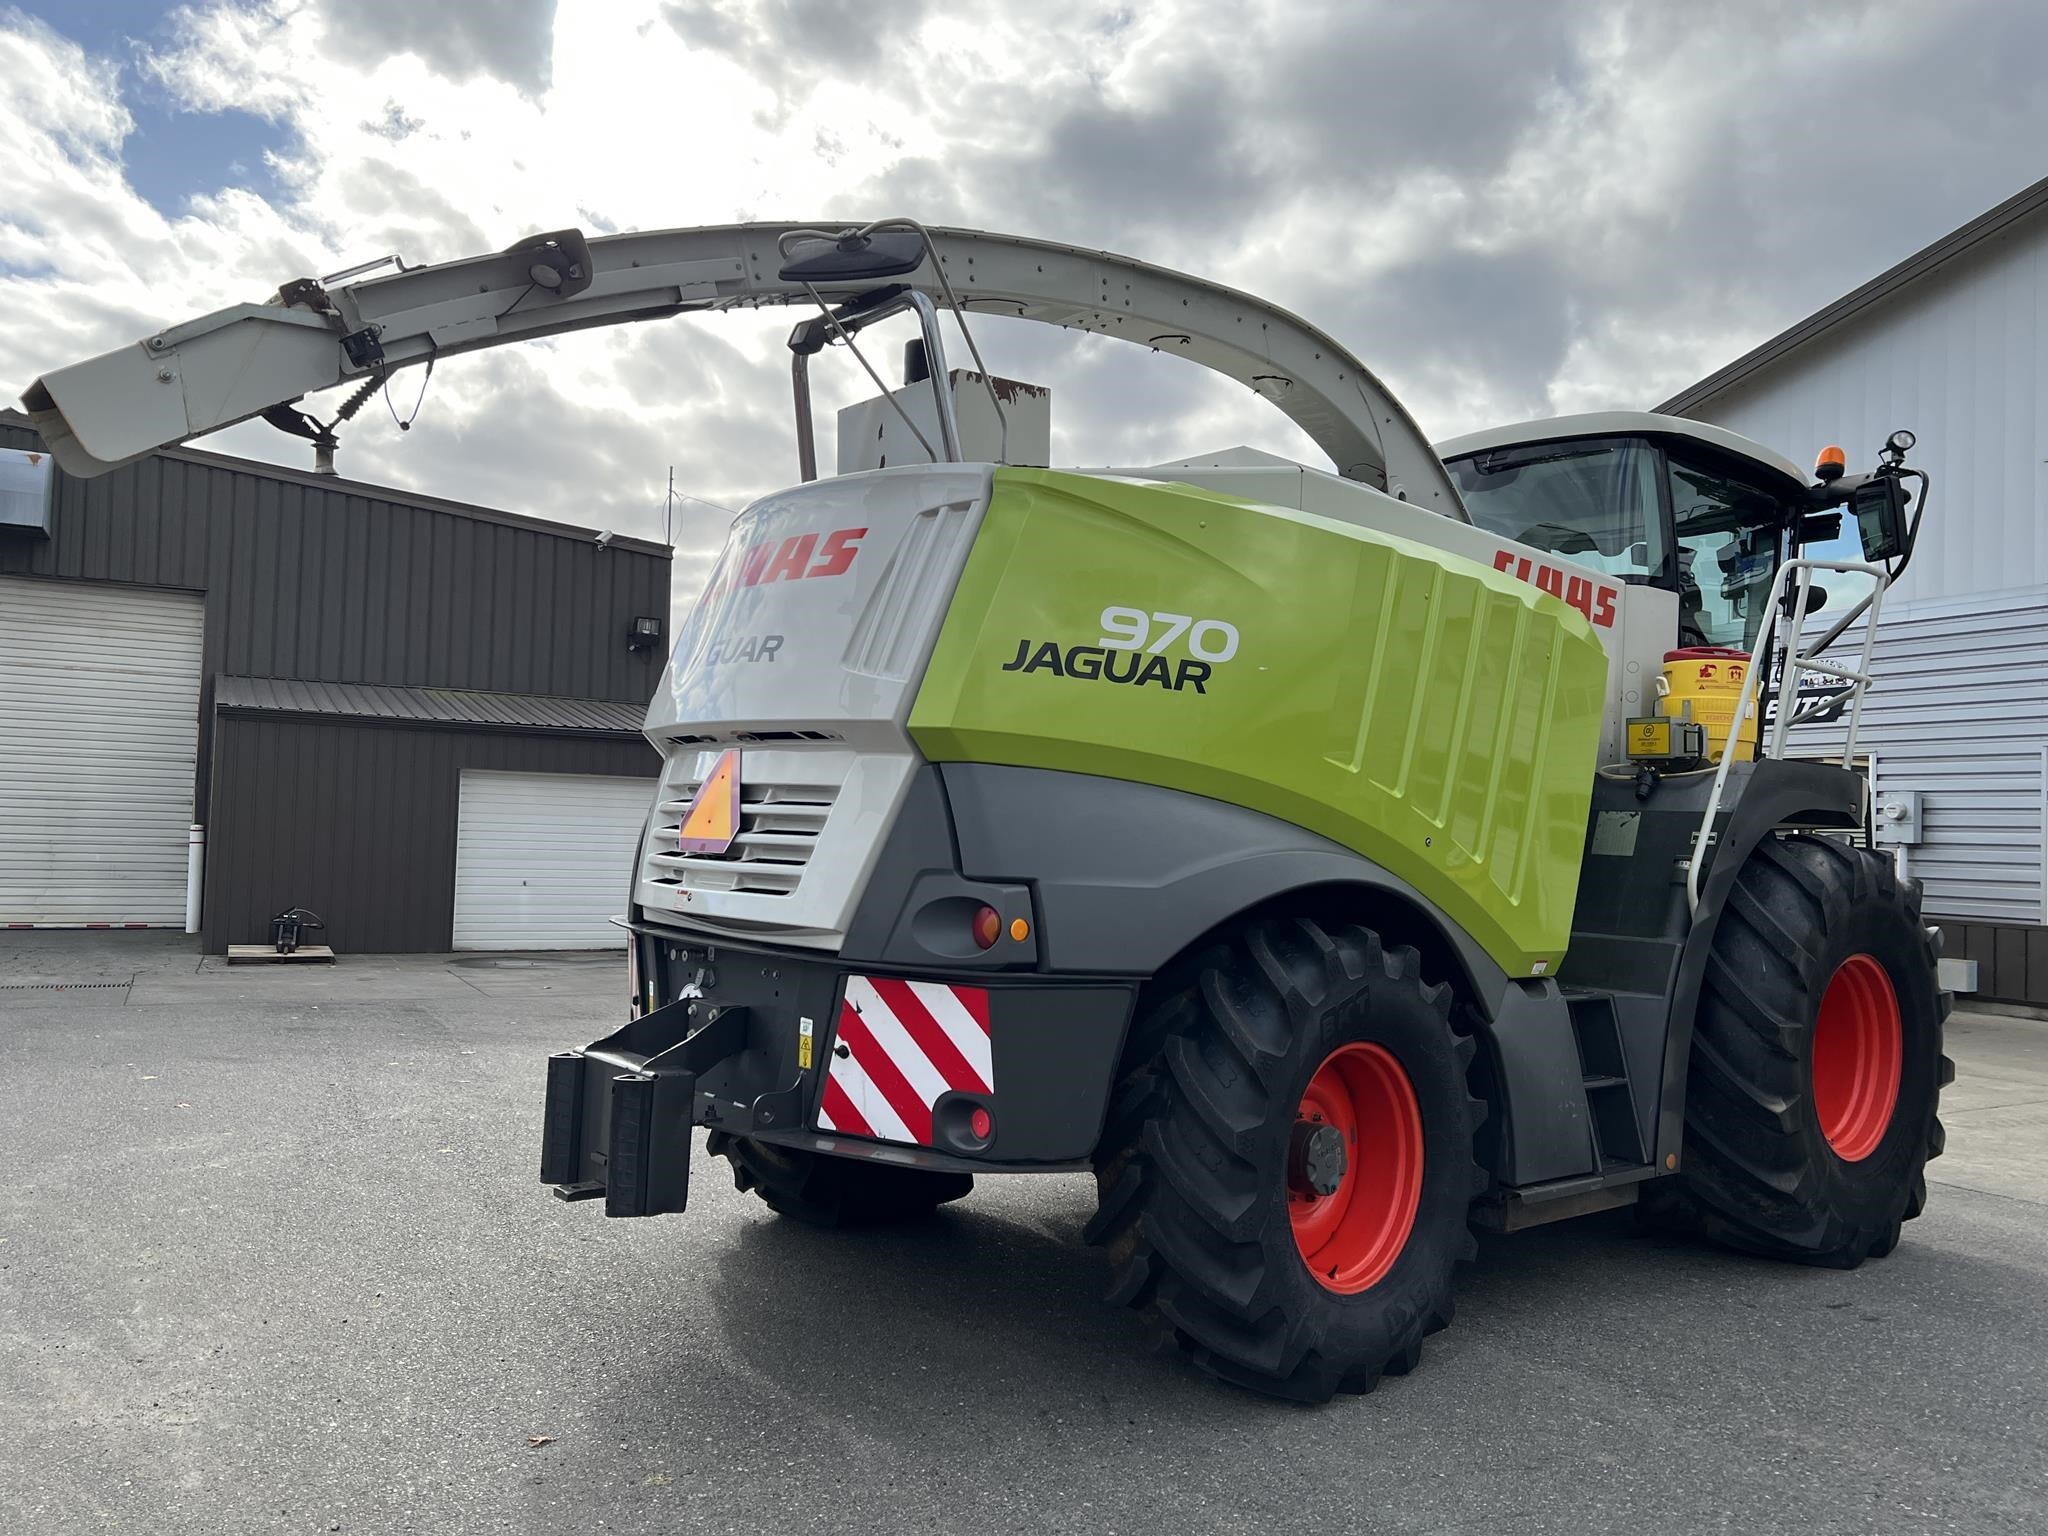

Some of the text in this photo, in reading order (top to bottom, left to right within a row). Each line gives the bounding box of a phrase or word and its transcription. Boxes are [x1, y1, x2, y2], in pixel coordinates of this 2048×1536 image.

[703, 527, 869, 606] AAS
[707, 635, 785, 667] GUAR
[1098, 605, 1240, 663] 970
[1002, 639, 1212, 694] JAGUAR
